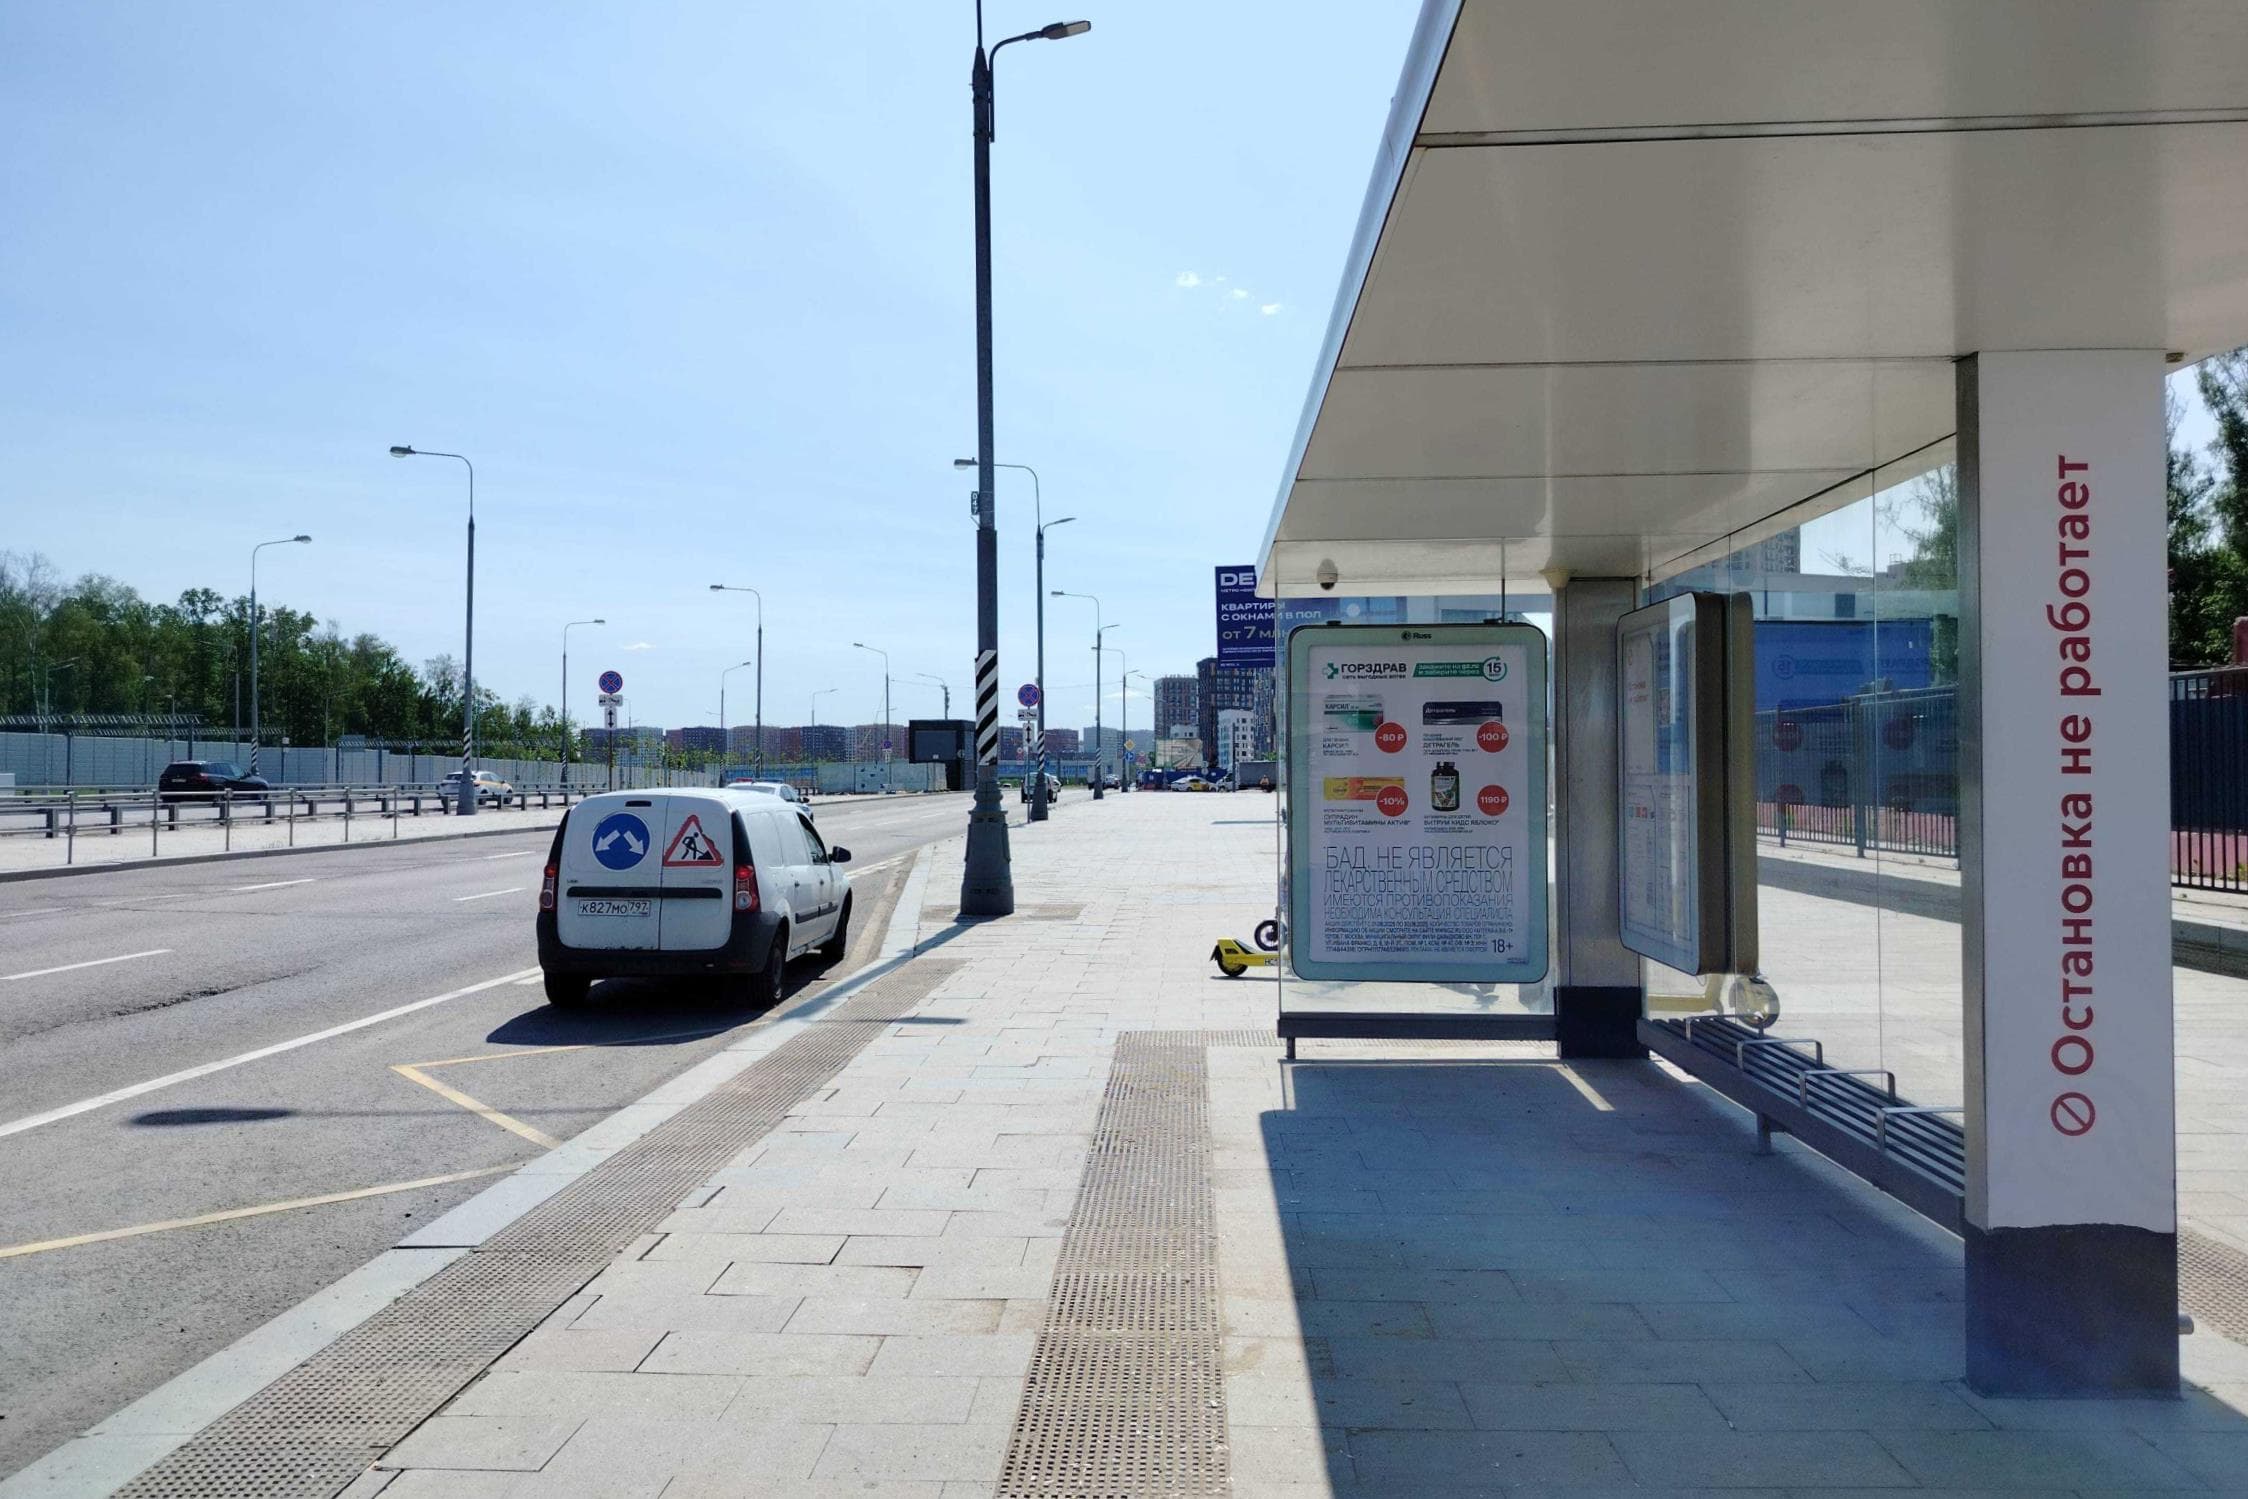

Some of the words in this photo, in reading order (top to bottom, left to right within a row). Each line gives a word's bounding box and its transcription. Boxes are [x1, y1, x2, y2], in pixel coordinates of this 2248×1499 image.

[1220, 573, 1255, 586] DE
[2046, 455, 2102, 697] работает
[1221, 602, 1286, 611] КВАРТИРЫ
[1295, 611, 1321, 619] ПОЛ
[1243, 626, 1256, 639] 7
[1341, 663, 1407, 674] ГОРЗДРАВ
[1486, 662, 1501, 673] 15
[2060, 714, 2092, 775] не
[1480, 796, 1500, 804] 1190
[1377, 846, 1402, 869] НЕ
[1408, 846, 1513, 869] ЯВЛЯЕТСЯ
[1323, 870, 1432, 893] ЛЕКАРСТВЕННЫМ
[1436, 870, 1513, 893] СРЕДСТВОМ
[1323, 894, 1383, 907] ИМЕЮТСЯ
[581, 902, 628, 914] К827МО
[628, 901, 647, 911] 797
[2050, 792, 2095, 1077] Остановка
[1491, 939, 1514, 953] 18+
